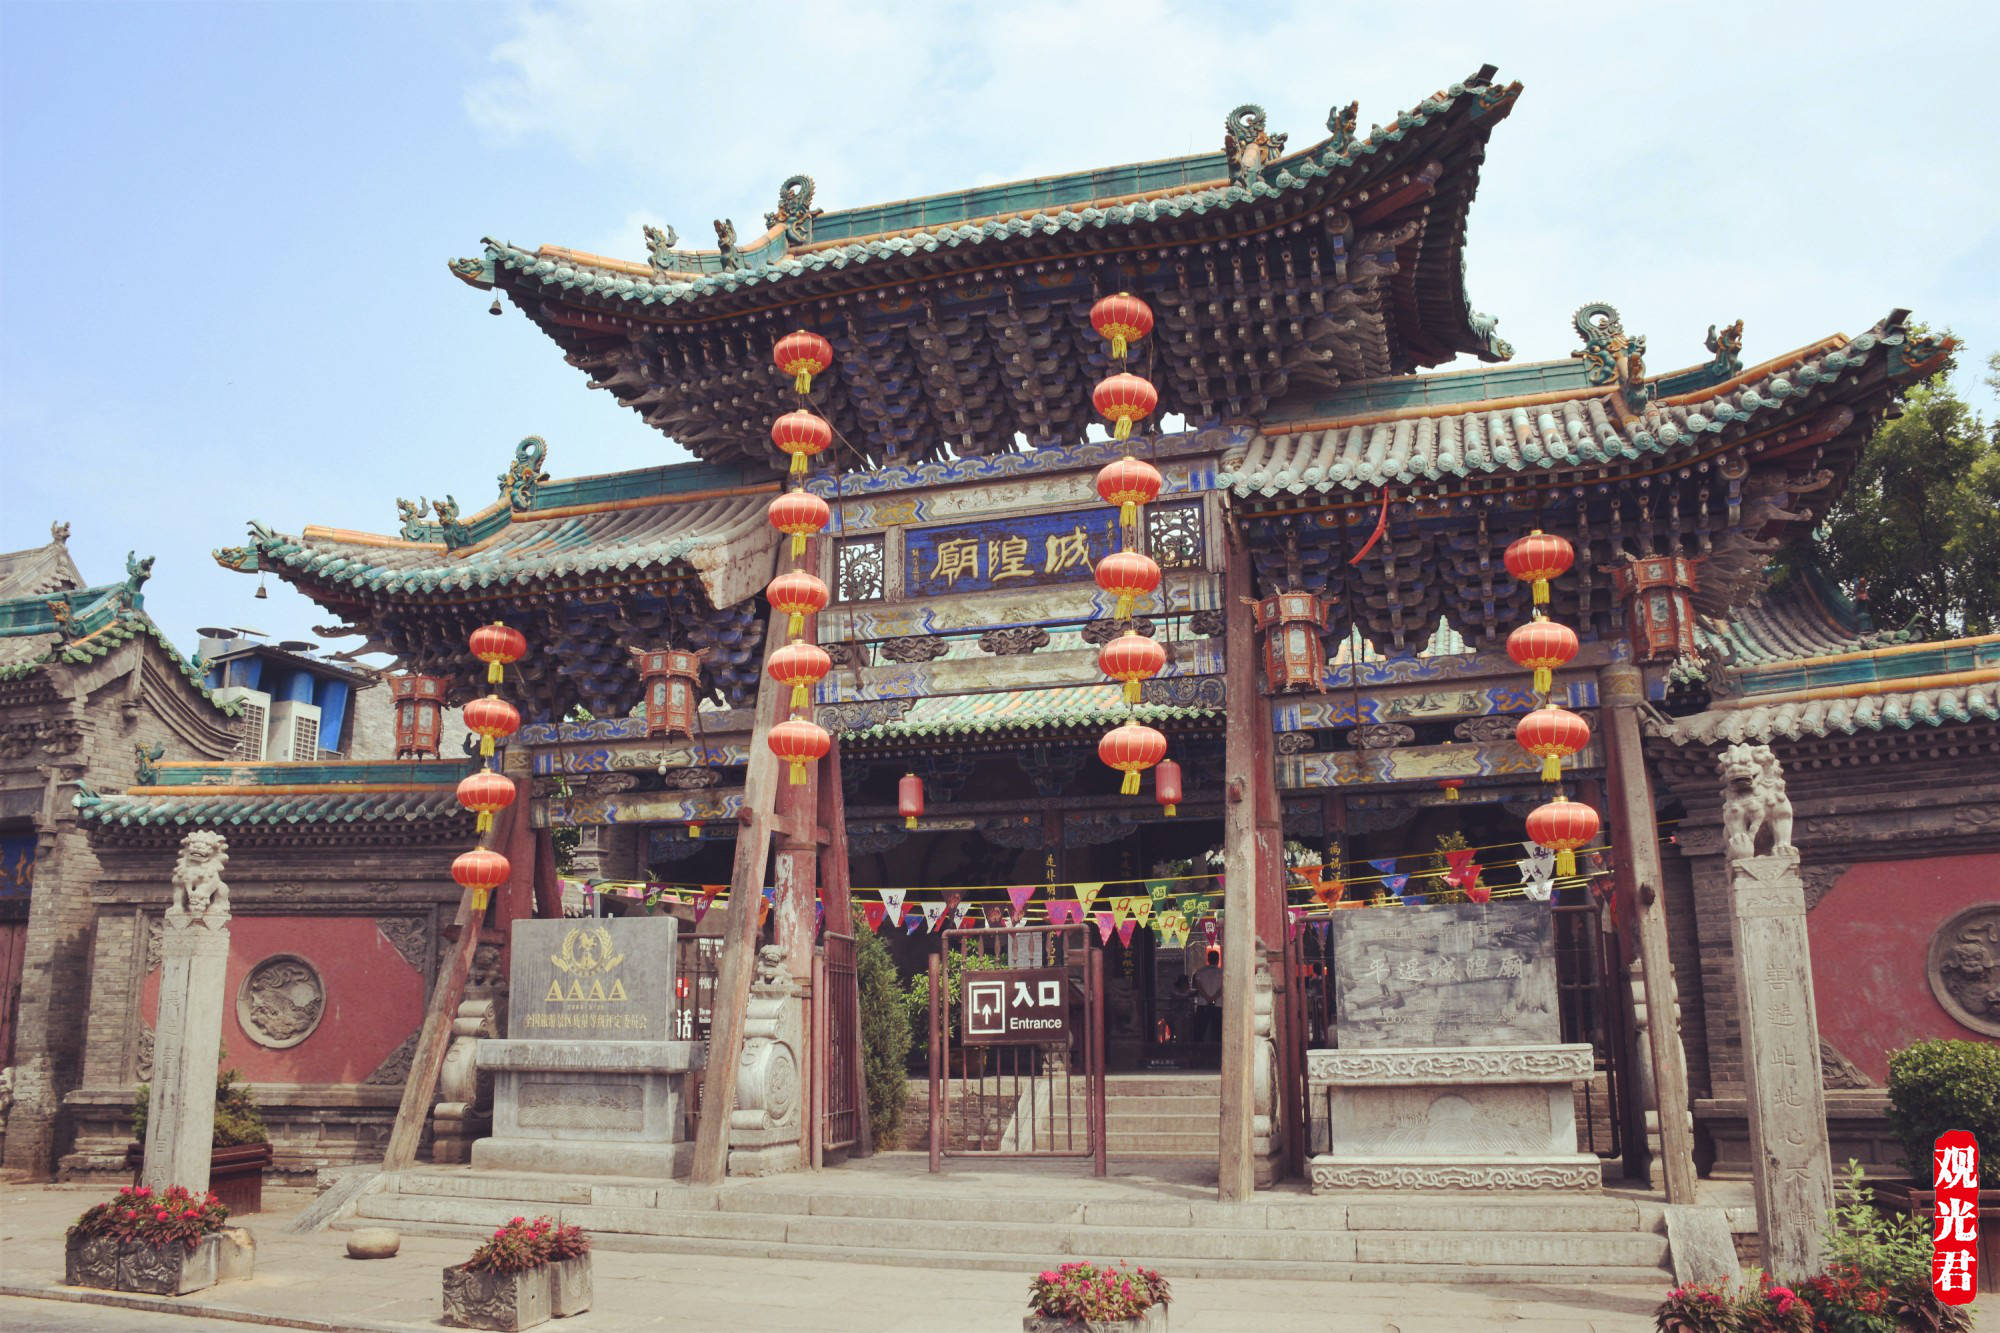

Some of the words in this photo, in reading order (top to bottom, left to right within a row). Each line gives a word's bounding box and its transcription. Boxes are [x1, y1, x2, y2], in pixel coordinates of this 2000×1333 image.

[544, 978, 628, 1002] AAAA
[1011, 980, 1061, 1009] 入口
[1010, 1017, 1063, 1030] Entrance
